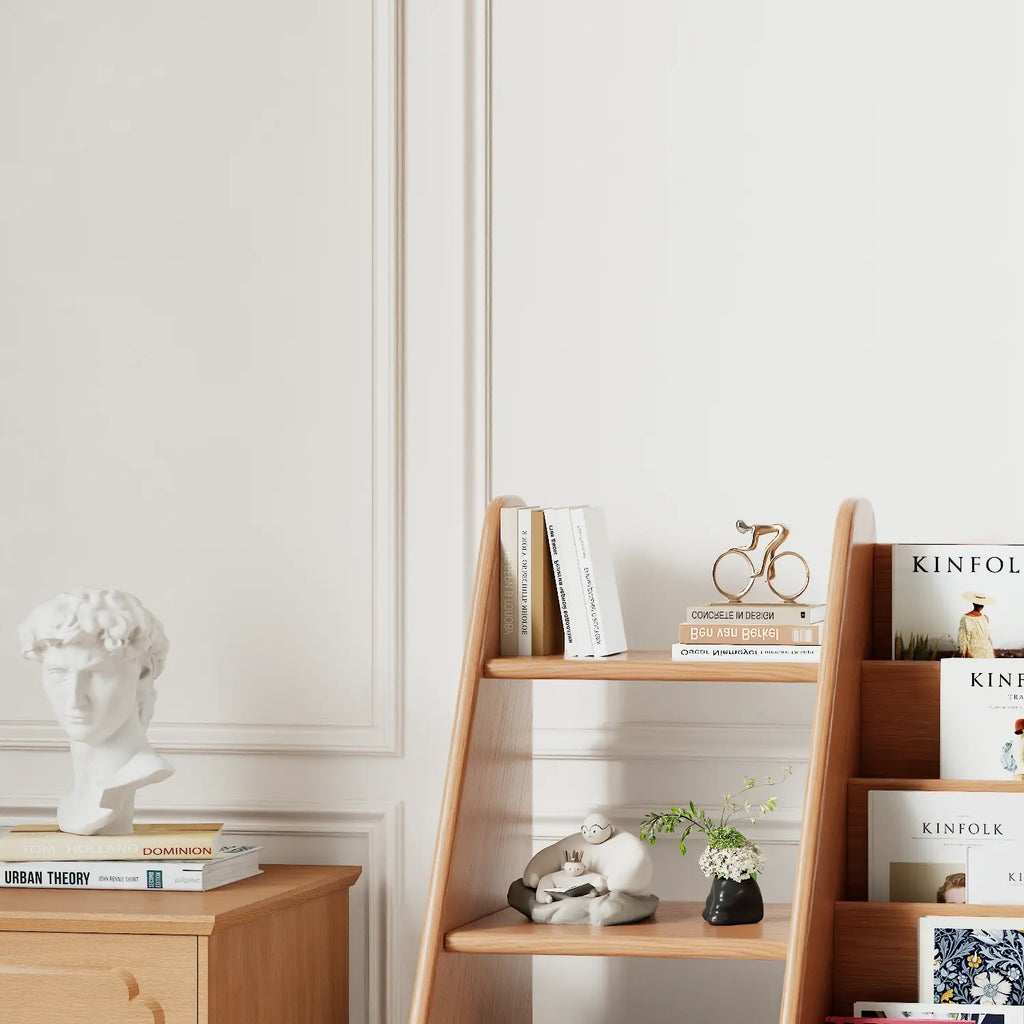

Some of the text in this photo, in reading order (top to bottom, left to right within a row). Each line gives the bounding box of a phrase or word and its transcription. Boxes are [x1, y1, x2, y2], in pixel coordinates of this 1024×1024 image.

[922, 822, 1004, 836] KINFOLK
[142, 846, 212, 856] DOMINION
[4, 870, 91, 886] URBAN THEORY
